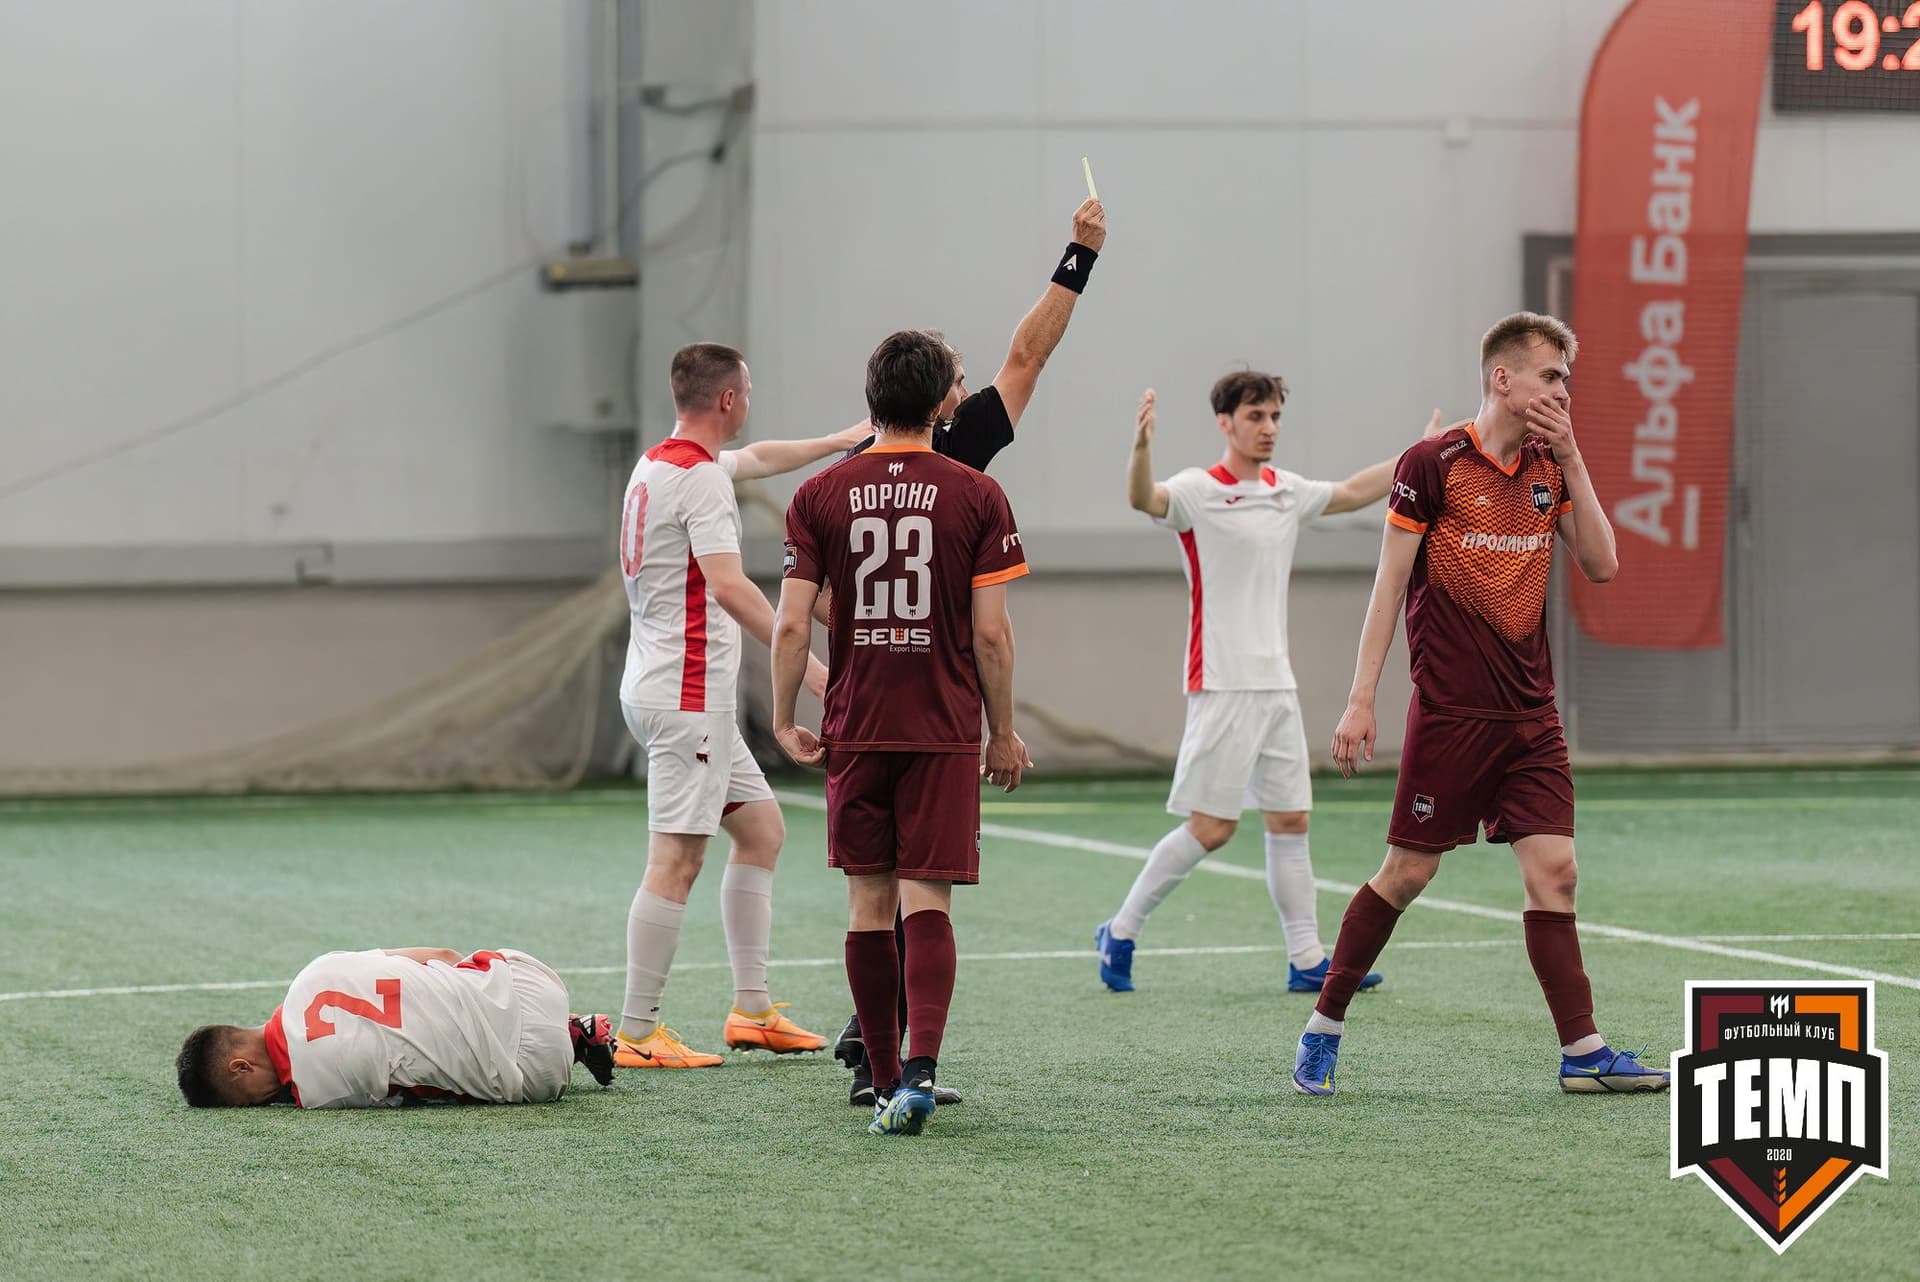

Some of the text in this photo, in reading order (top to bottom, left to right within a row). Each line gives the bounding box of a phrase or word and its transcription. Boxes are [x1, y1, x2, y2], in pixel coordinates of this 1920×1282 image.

[1614, 96, 1701, 546] Альфа Банк
[849, 482, 938, 514] ВОРОНА
[1394, 481, 1418, 502] ПСБ
[850, 515, 933, 620] 23
[854, 627, 931, 646] SEUS
[889, 645, 931, 654] Export Union
[304, 978, 402, 1042] 2
